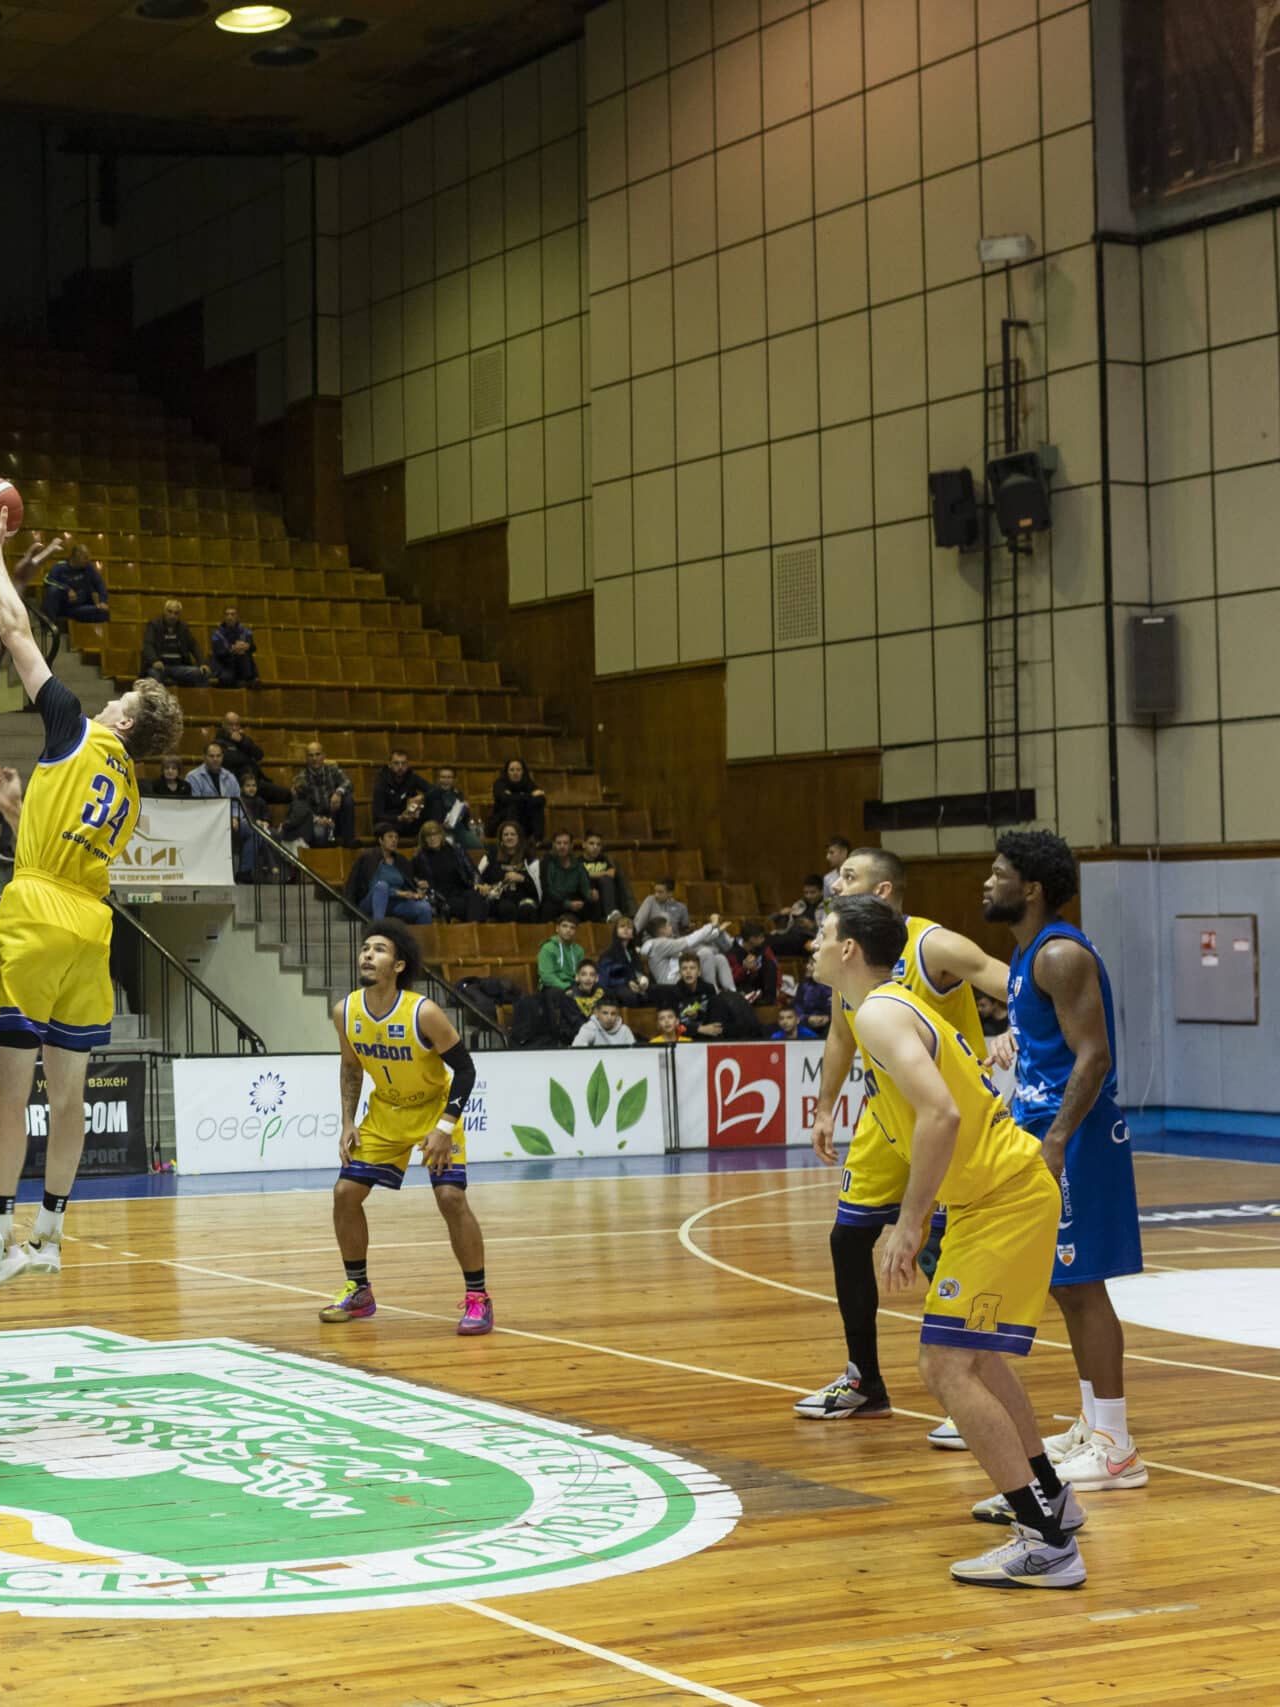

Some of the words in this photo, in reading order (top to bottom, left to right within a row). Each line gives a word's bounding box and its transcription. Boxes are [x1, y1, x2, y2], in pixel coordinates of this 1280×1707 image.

[82, 774, 130, 847] 34
[112, 846, 184, 867] АСИК
[88, 1077, 128, 1088] важен
[382, 1065, 392, 1085] 1
